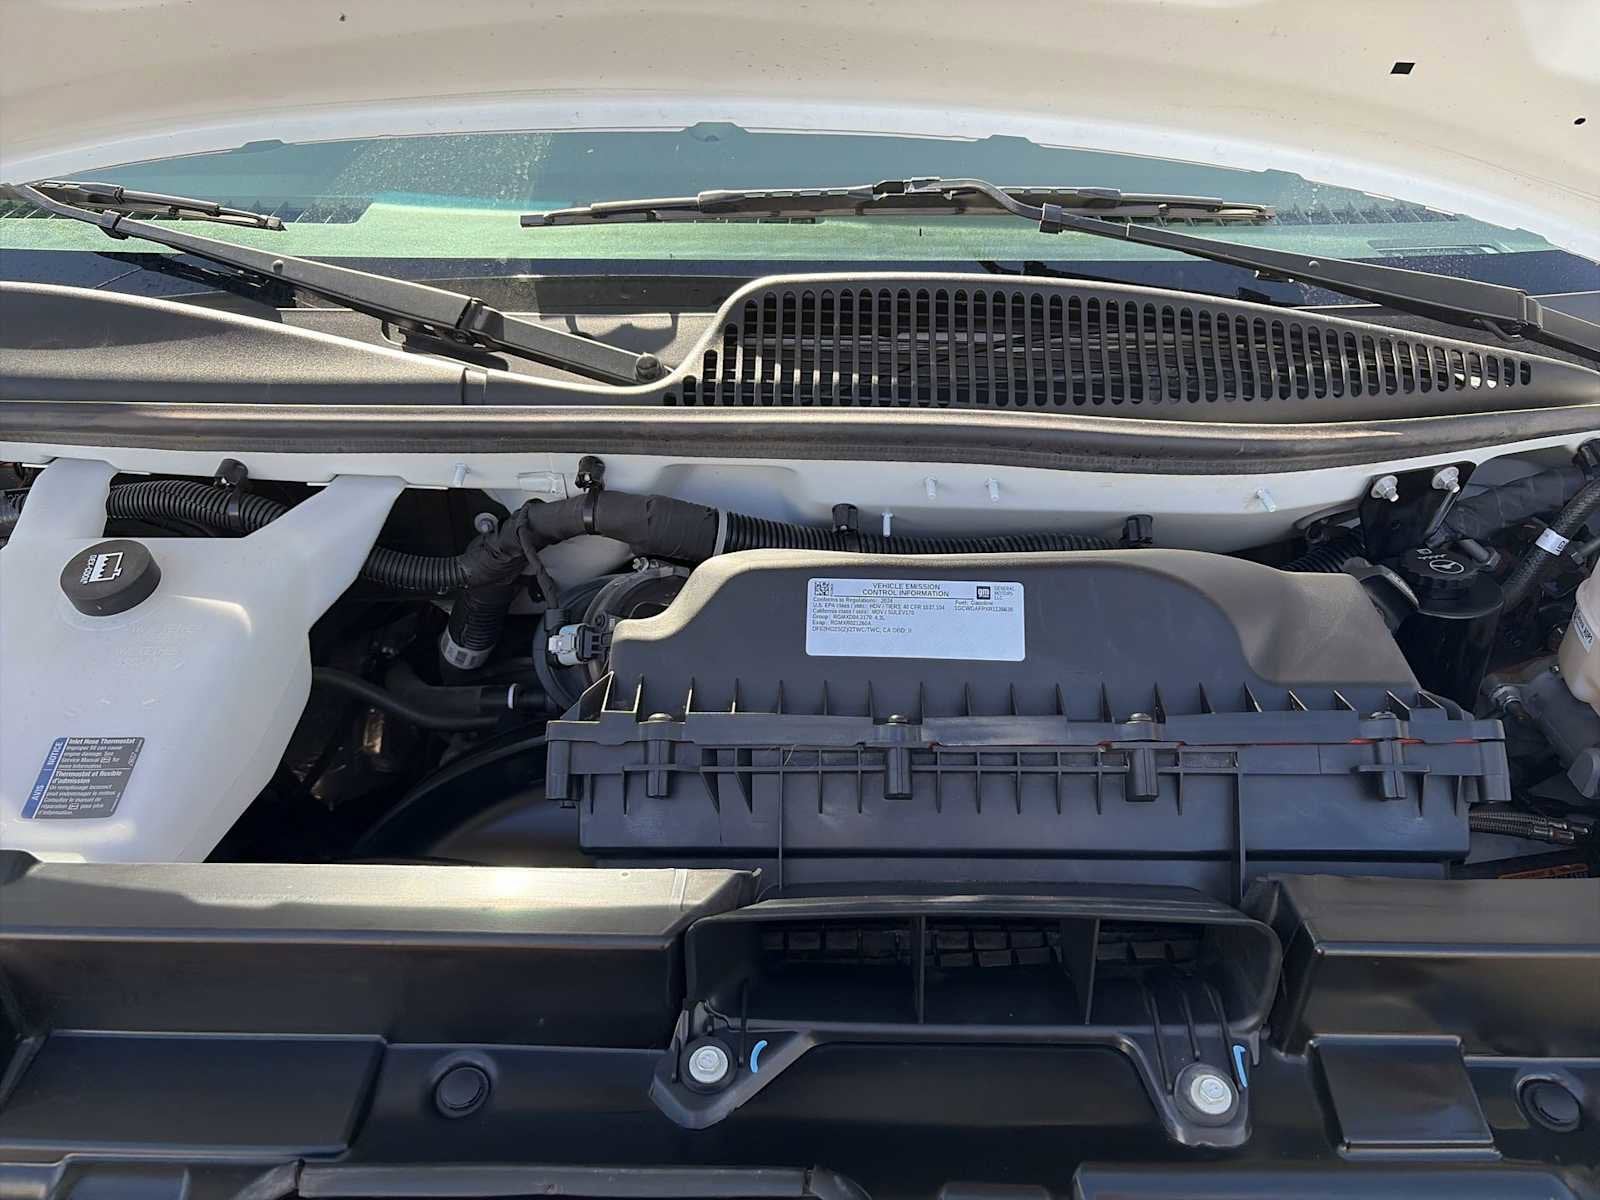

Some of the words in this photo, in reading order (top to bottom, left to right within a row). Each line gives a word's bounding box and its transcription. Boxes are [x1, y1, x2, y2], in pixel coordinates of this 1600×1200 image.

[898, 589, 949, 597] INFORMATION
[47, 741, 63, 765] NOTICE
[31, 785, 45, 801] AVIS
